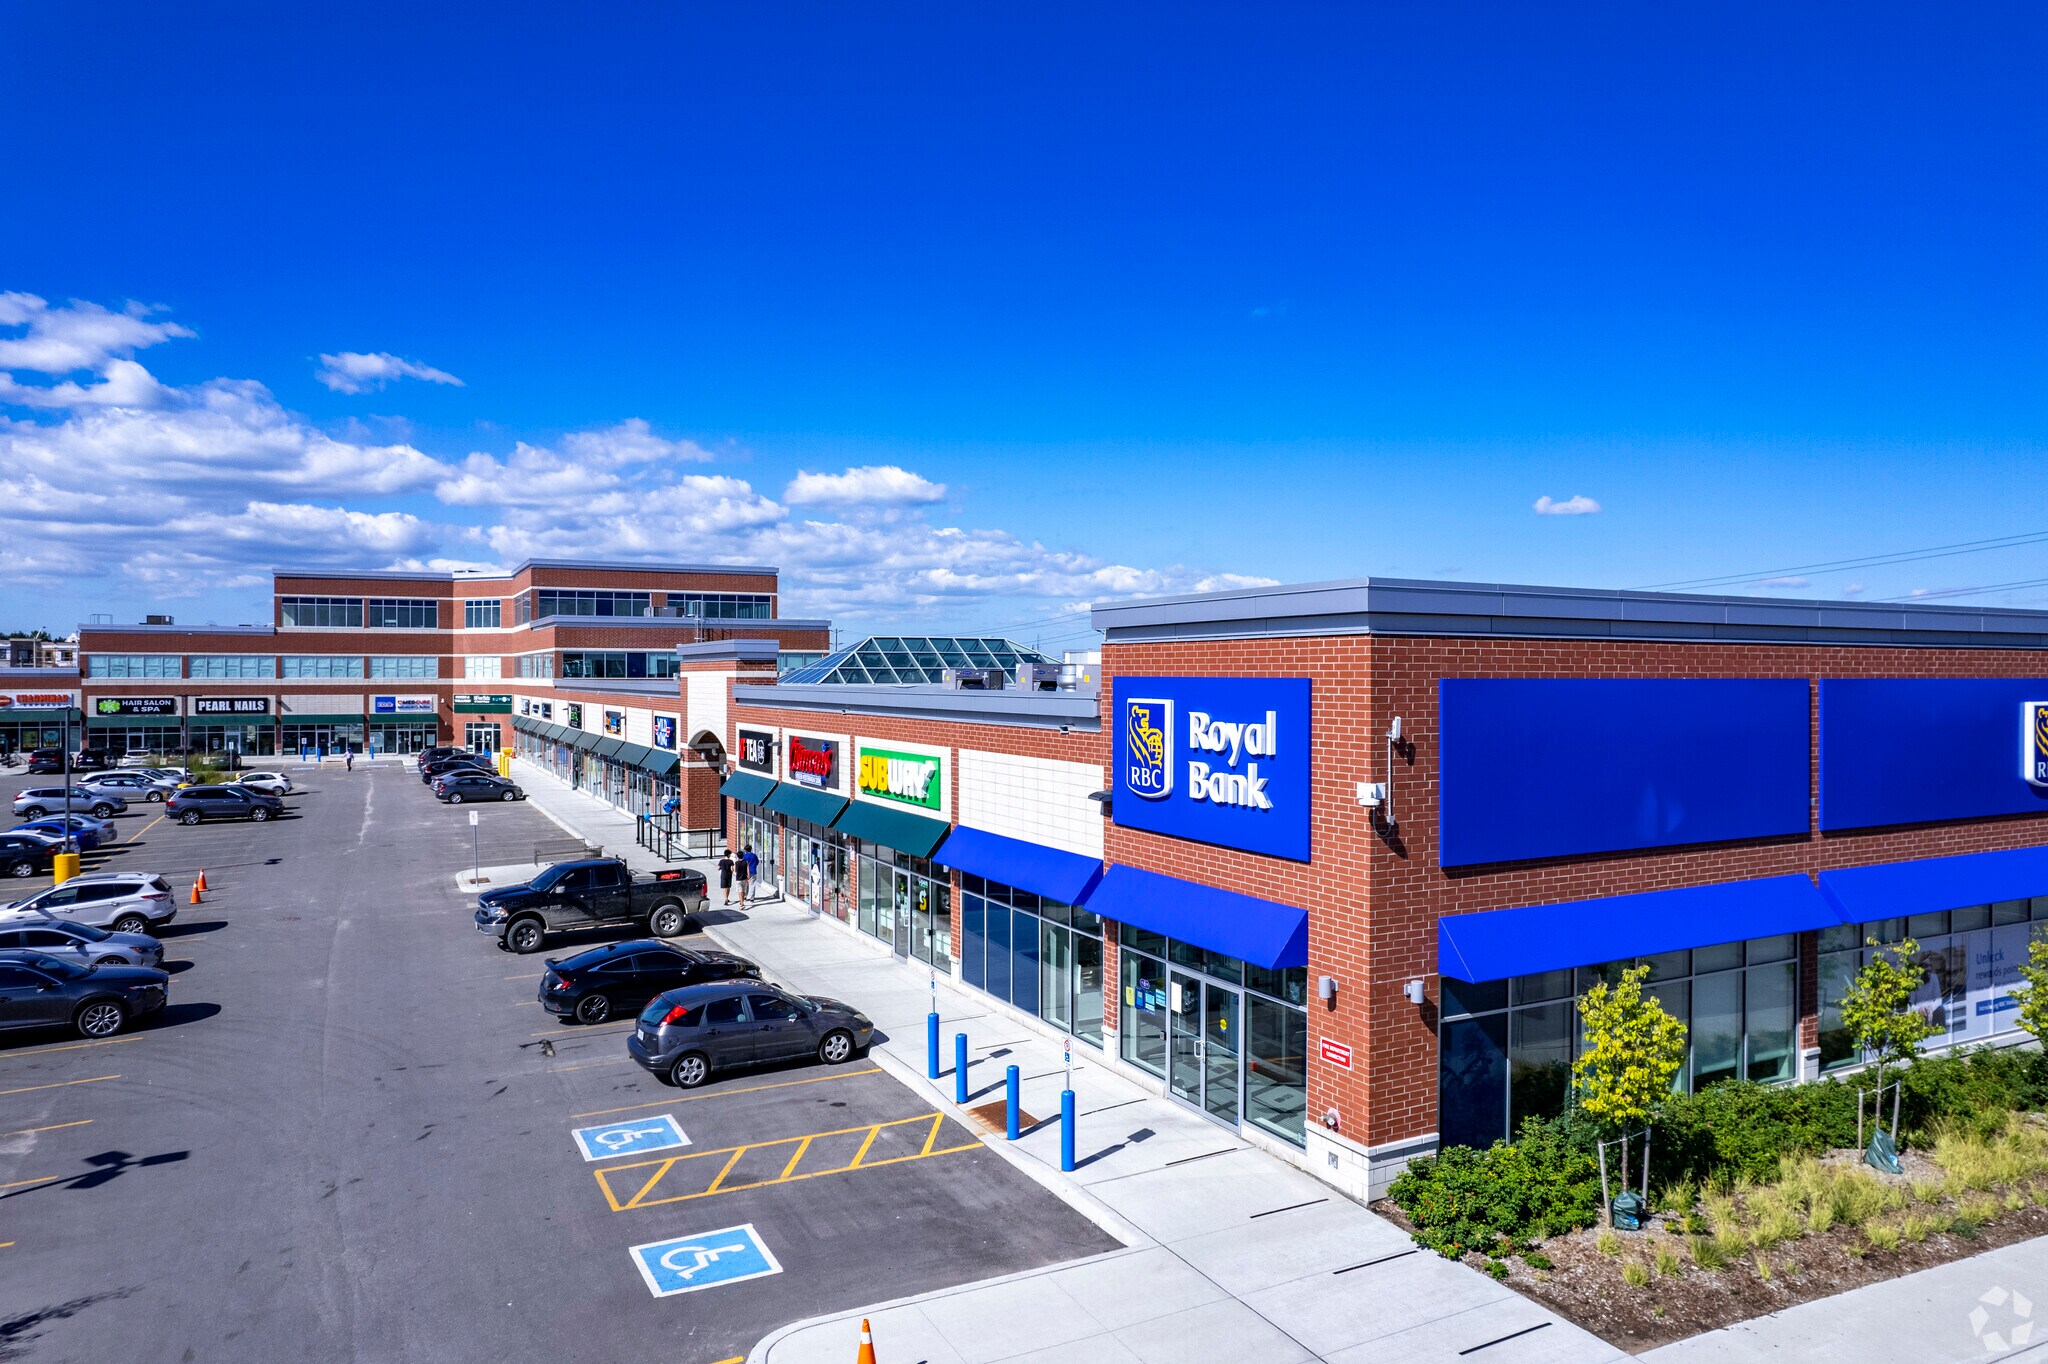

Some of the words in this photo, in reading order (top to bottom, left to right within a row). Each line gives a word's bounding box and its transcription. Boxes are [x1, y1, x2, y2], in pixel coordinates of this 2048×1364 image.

[16, 694, 68, 703] CHARMINAR
[198, 701, 231, 711] PEARL
[234, 701, 265, 711] NAILS
[1188, 710, 1277, 767] Royal
[858, 755, 936, 799] SUBWAY
[1131, 766, 1162, 789] RBC
[1188, 761, 1274, 809] Bank
